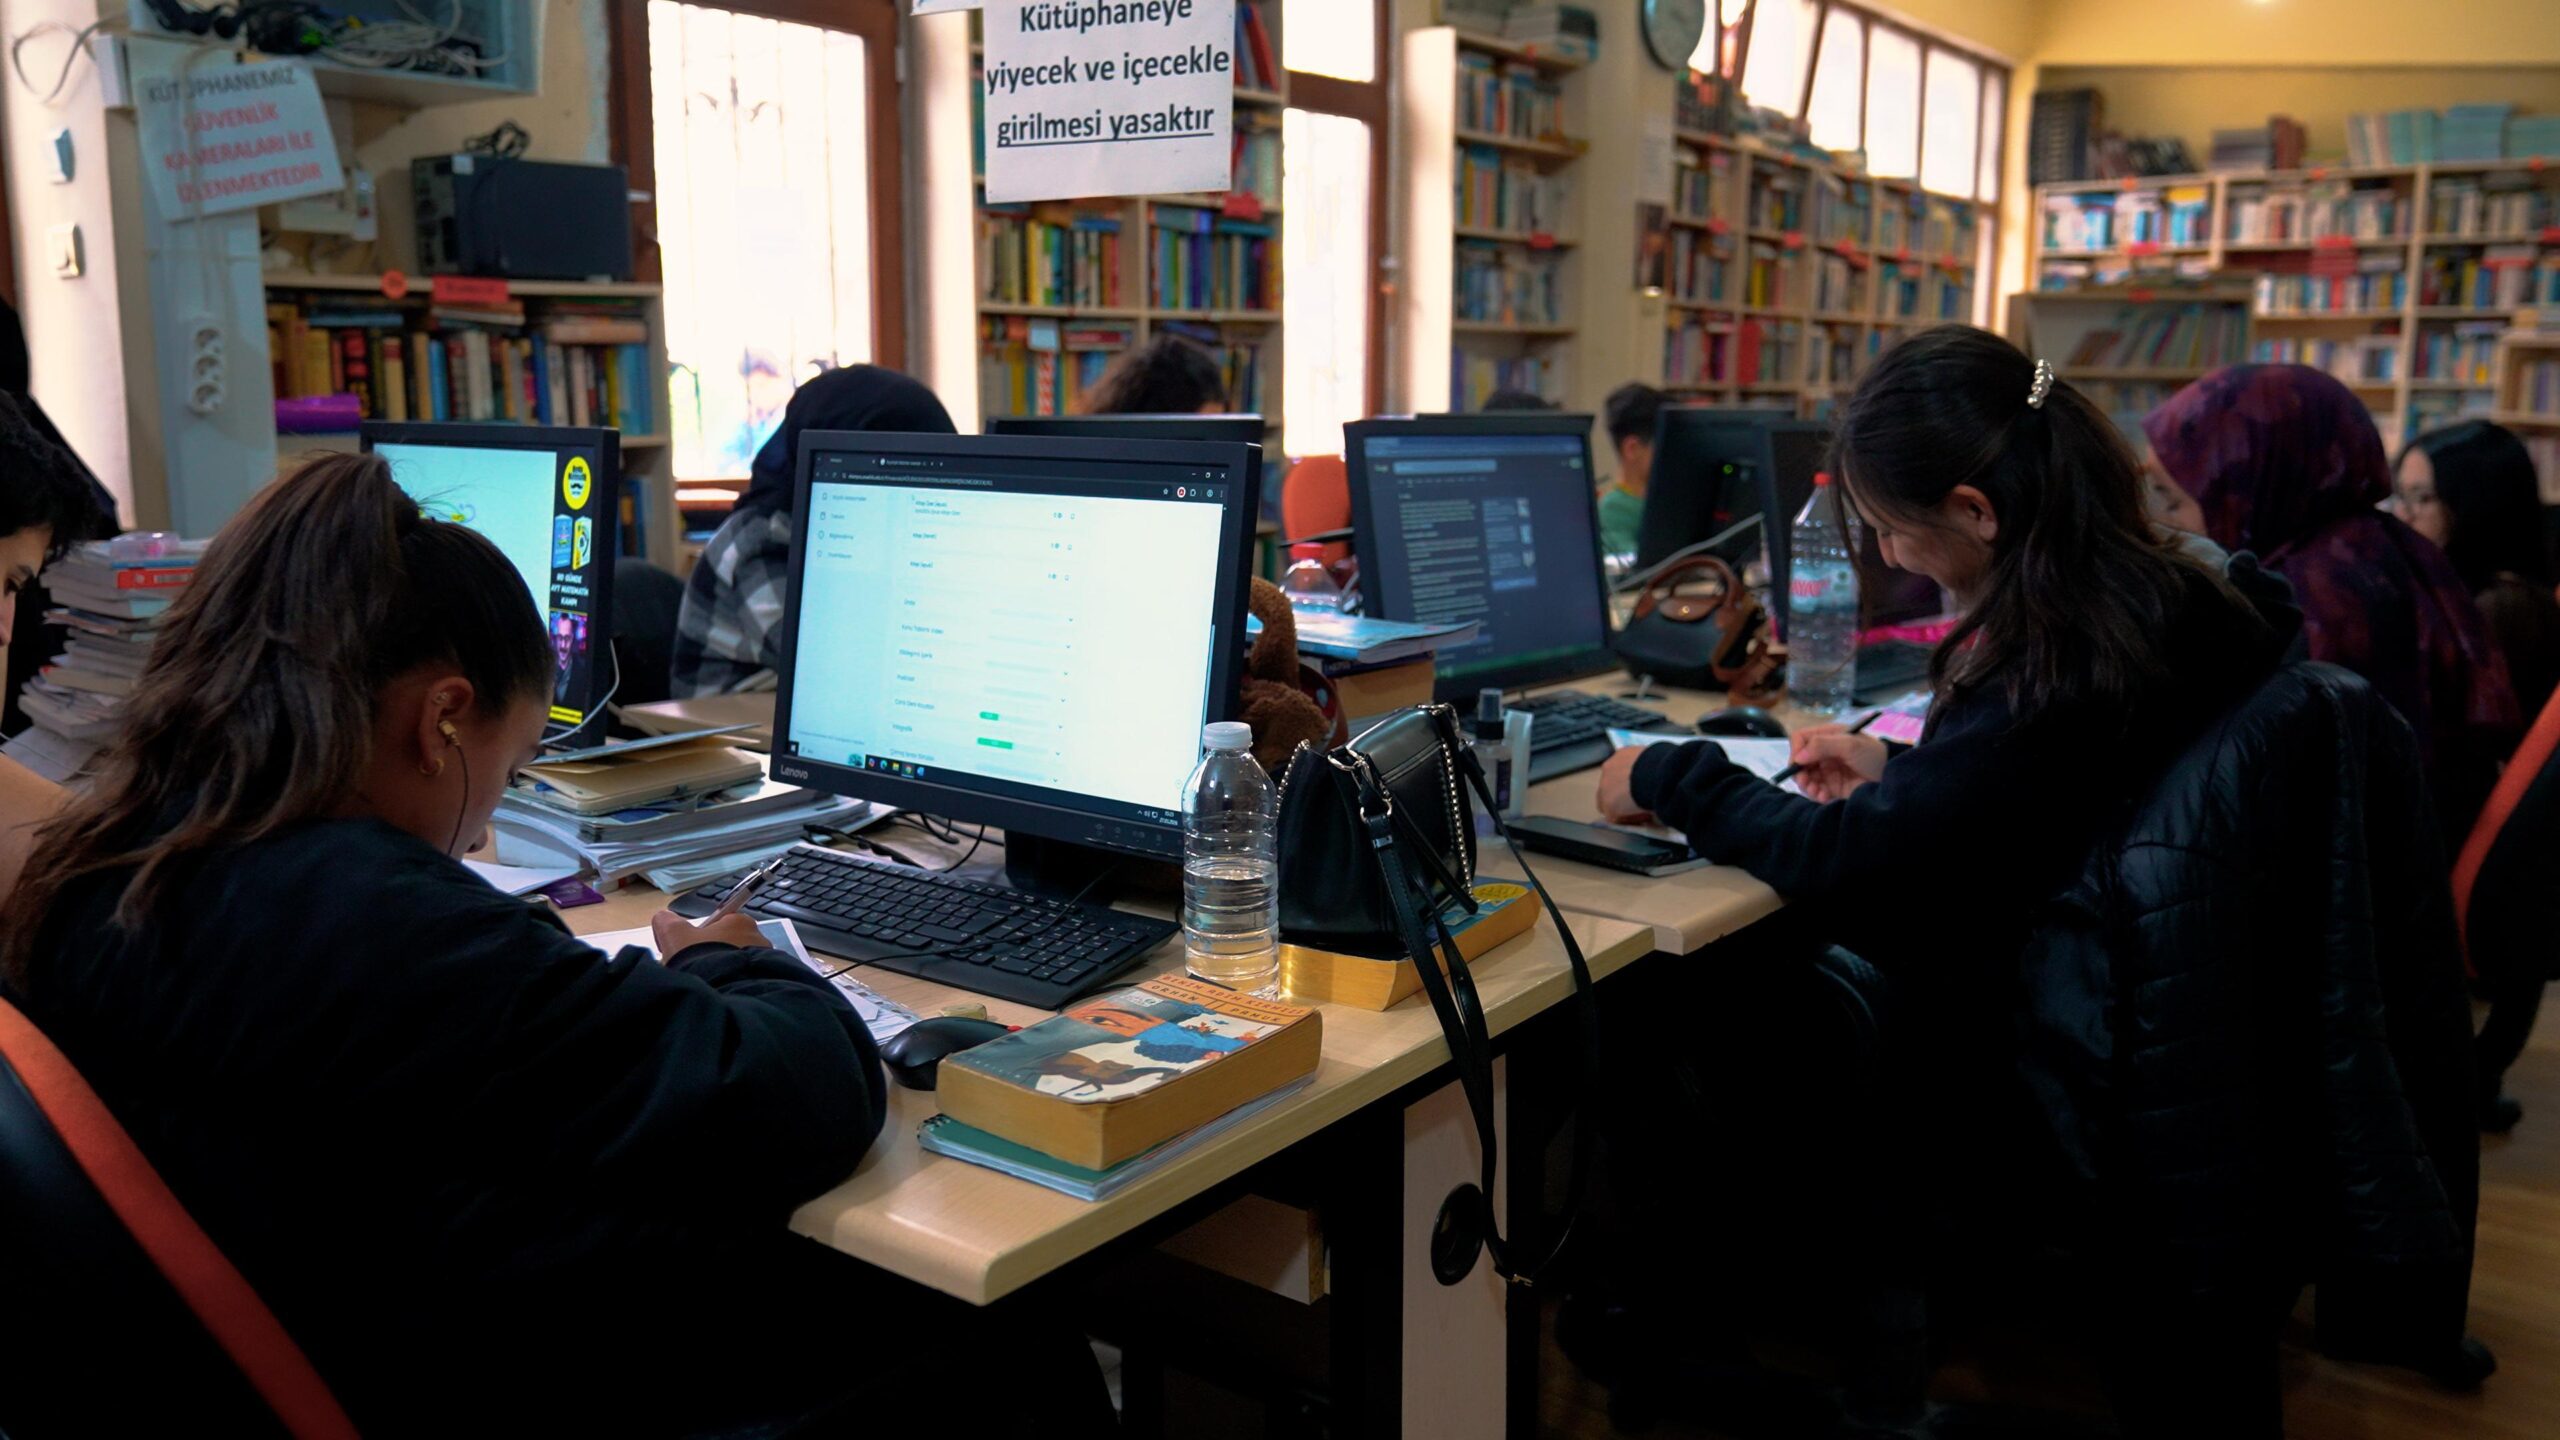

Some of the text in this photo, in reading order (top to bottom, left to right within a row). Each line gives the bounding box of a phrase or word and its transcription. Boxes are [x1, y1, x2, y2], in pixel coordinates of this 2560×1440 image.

[1021, 0, 1192, 33] Kütüphaneye
[987, 44, 1230, 95] yiyecek ve içecekle
[183, 101, 280, 133] GÜVENLİK
[998, 104, 1215, 146] girilmesi yasaktır
[780, 764, 809, 780] Lenovo
[1152, 984, 1200, 1001] ORHAN
[1230, 1007, 1281, 1023] PAMUK
[1207, 988, 1242, 1002] ADIM
[1246, 999, 1306, 1015] KIRMIZI
